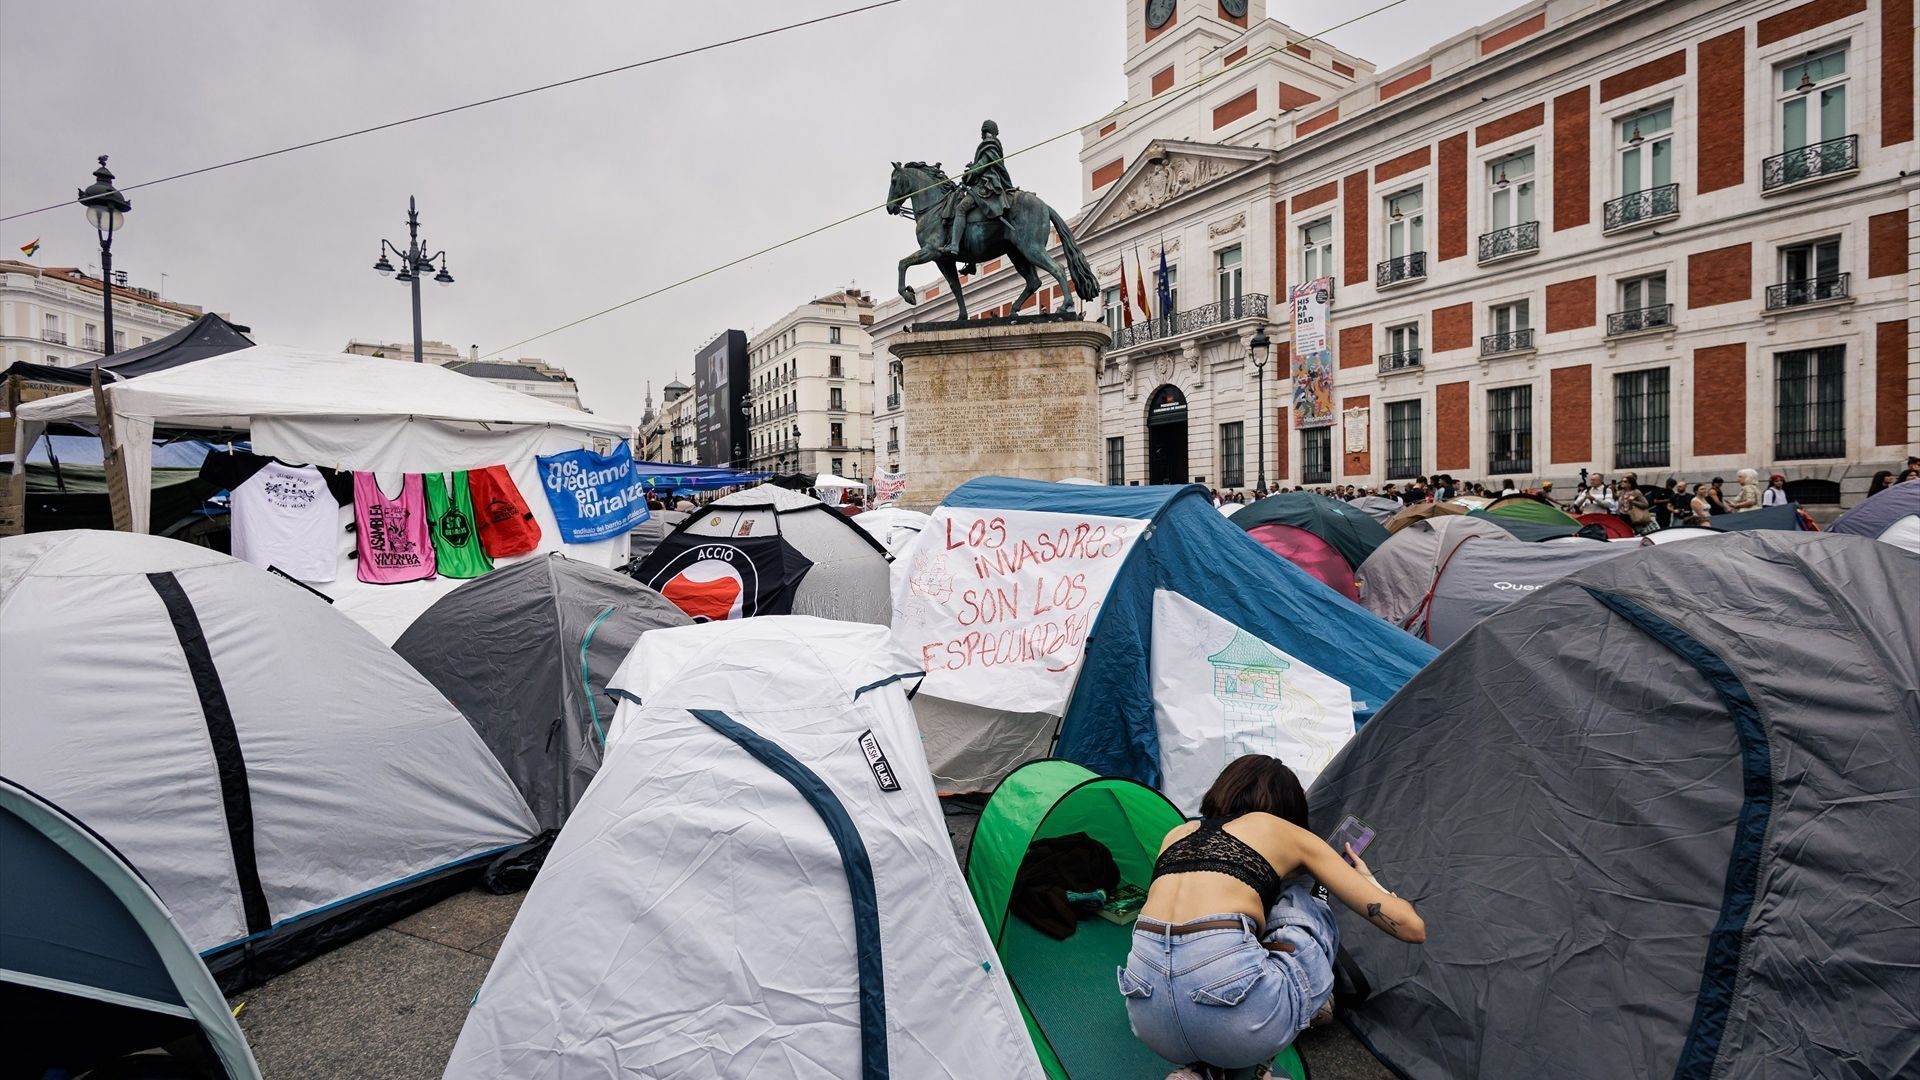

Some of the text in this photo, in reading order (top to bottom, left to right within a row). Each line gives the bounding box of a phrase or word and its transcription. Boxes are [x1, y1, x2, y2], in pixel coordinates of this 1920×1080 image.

[1297, 297, 1310, 306] HIS
[1297, 304, 1308, 312] PA
[1297, 311, 1306, 319] NI
[1297, 316, 1314, 325] DAD
[550, 460, 579, 478] nos
[575, 487, 598, 503] en
[369, 504, 386, 552] ASAMBLEA
[946, 517, 1007, 550] LOS
[374, 552, 419, 560] VIVIENDA
[697, 546, 734, 561] ACCIÓ
[374, 558, 421, 566] VILLALBA
[957, 573, 1088, 626] SON LOS
[863, 737, 893, 788] FRESH BLACK
